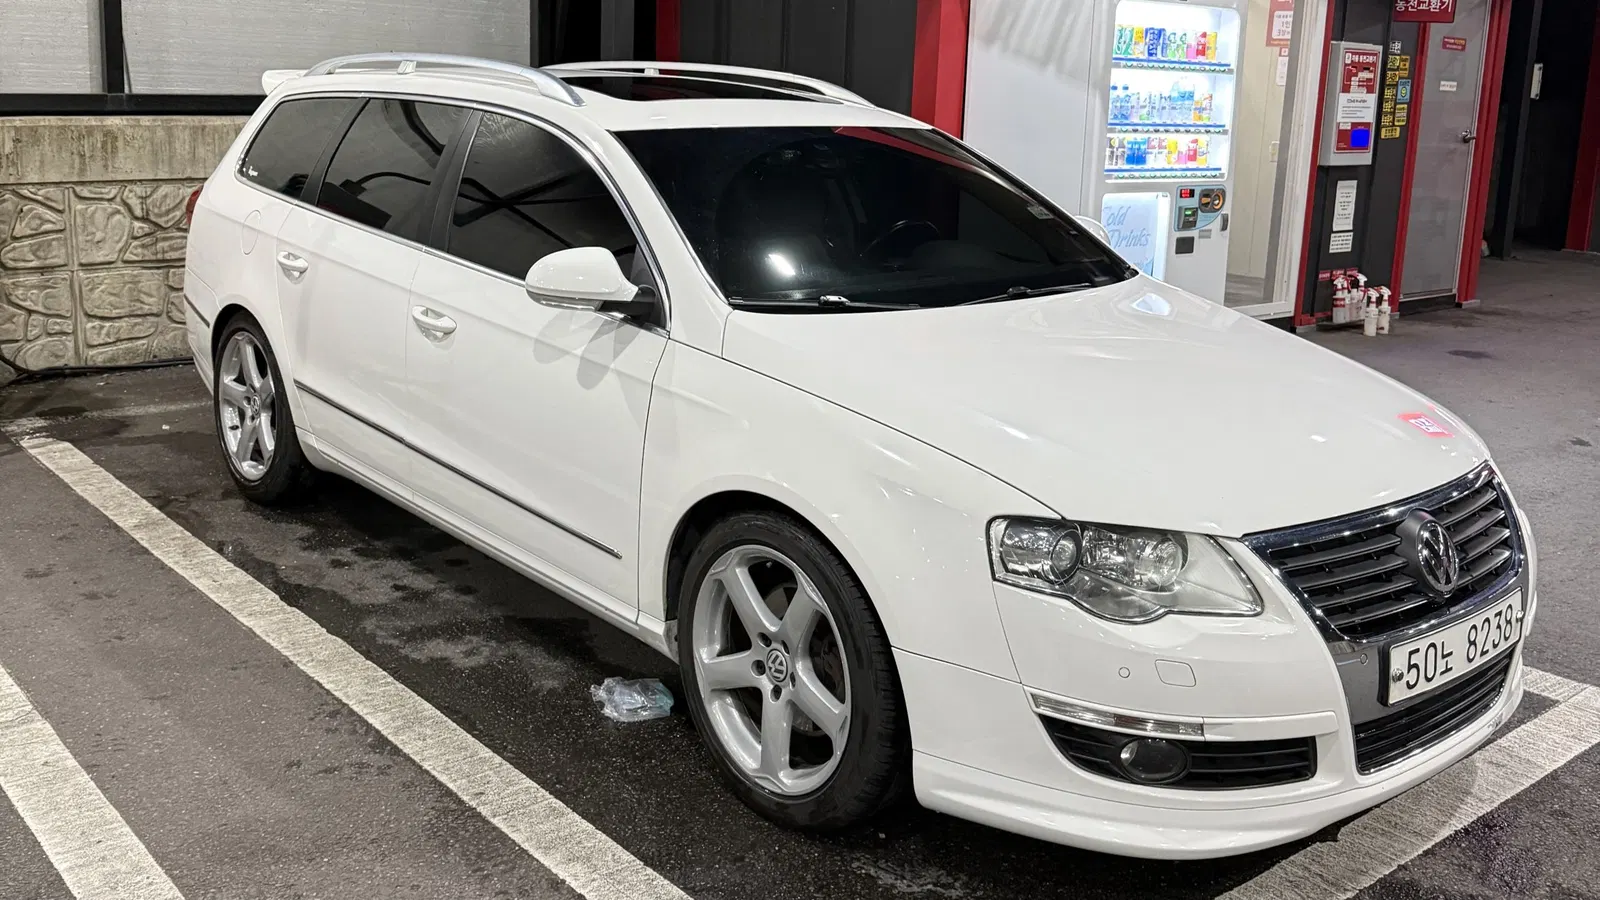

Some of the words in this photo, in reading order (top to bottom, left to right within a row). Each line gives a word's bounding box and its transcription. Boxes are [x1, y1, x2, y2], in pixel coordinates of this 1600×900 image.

[1395, 0, 1453, 12] 동전교환기
[1108, 227, 1151, 249] Drinks
[1405, 640, 1454, 690] 50노
[1466, 603, 1513, 664] 8238
